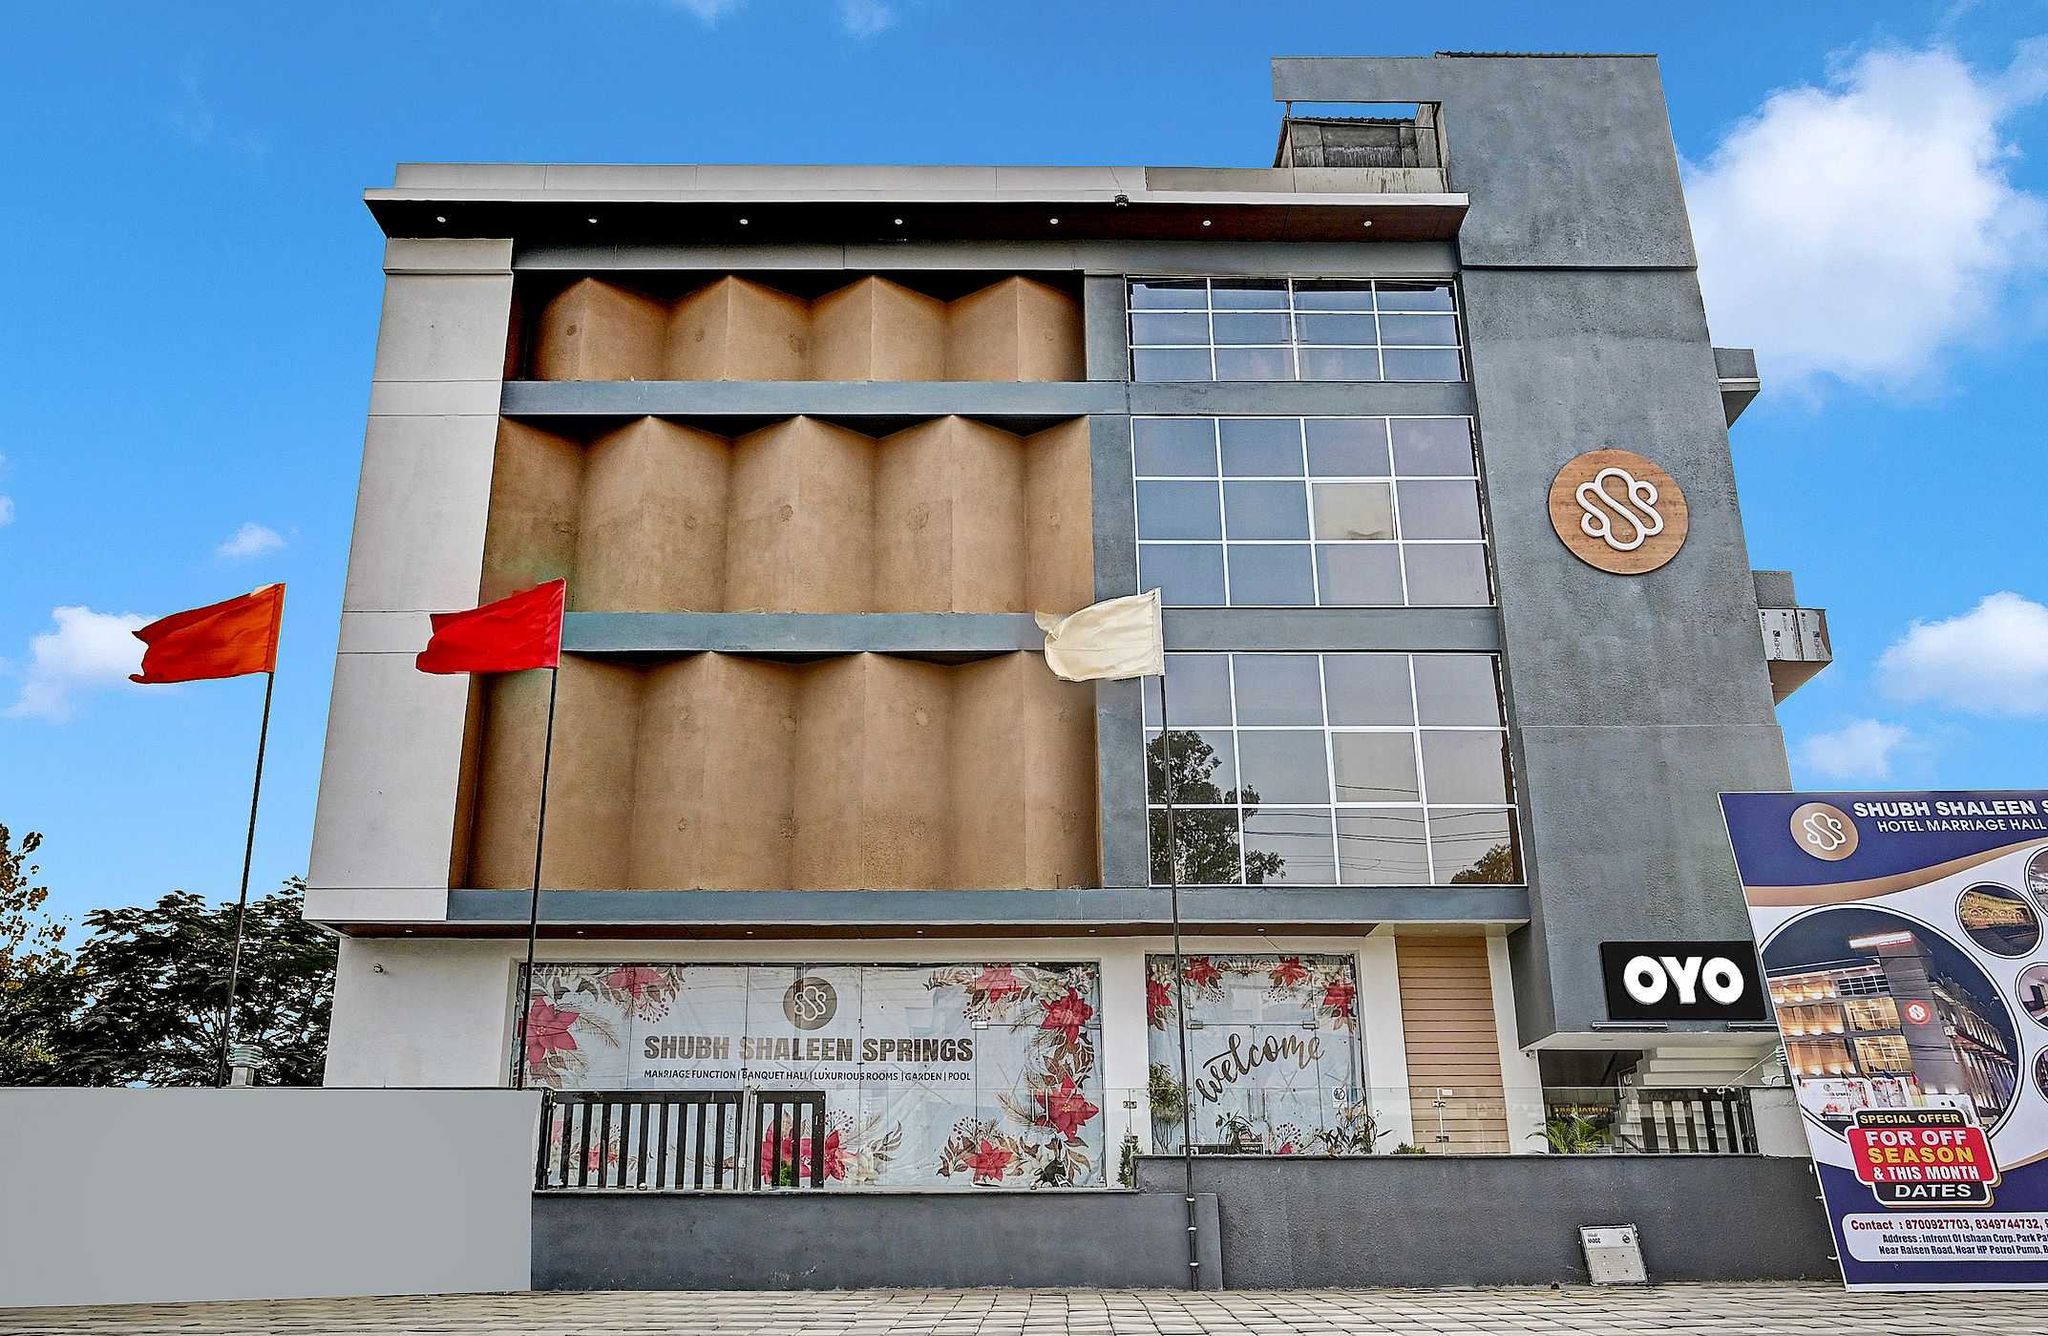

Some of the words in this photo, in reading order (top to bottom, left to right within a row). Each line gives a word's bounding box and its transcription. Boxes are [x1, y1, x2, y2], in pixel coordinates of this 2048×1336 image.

[1853, 802, 1931, 817] SHUBH
[1935, 800, 2038, 816] SHALEEN
[1876, 820, 1925, 833] HOTEL
[1925, 819, 2007, 832] MARRIAGE
[2008, 818, 2048, 831] HALL
[1622, 955, 1745, 1006] OYO
[644, 1035, 730, 1060] SHUBH
[739, 1037, 853, 1062] SHALEEN
[862, 1038, 973, 1062] SPRINGS
[643, 1069, 690, 1079] MARRIAGE
[691, 1069, 736, 1080] FUNCTION
[742, 1070, 784, 1080] BANQUET
[786, 1071, 809, 1081] HALL
[814, 1071, 864, 1081] LUXURIOUS
[866, 1071, 898, 1081] ROOMS
[905, 1071, 942, 1081] GARDEN
[948, 1072, 971, 1081] POOL
[1195, 1032, 1326, 1107] welcome
[1860, 1114, 1915, 1124] SPECIAL
[1917, 1114, 1960, 1124] OFFER
[1865, 1130, 1916, 1146] FOR
[1921, 1130, 1967, 1146] OFF
[1867, 1147, 1974, 1164] SEASON
[1873, 1167, 1884, 1181] &
[1887, 1166, 1922, 1180] THIS
[1924, 1166, 1980, 1180] MONTH
[1895, 1184, 1972, 1198] DATES
[1851, 1220, 1894, 1231] Contact
[1905, 1219, 1974, 1231] 8700927703,
[1975, 1218, 2043, 1231] 8349744732,
[1882, 1234, 1918, 1243] Address
[1962, 1233, 1992, 1243] Ishaan
[1993, 1233, 2016, 1244] Corp.
[2016, 1233, 2036, 1243] Park
[1878, 1245, 1899, 1255] Near
[1900, 1245, 1930, 1255] Raisen
[1955, 1245, 1976, 1254] Near
[1976, 1245, 1988, 1254] HP
[1989, 1245, 2015, 1255] Petrol
